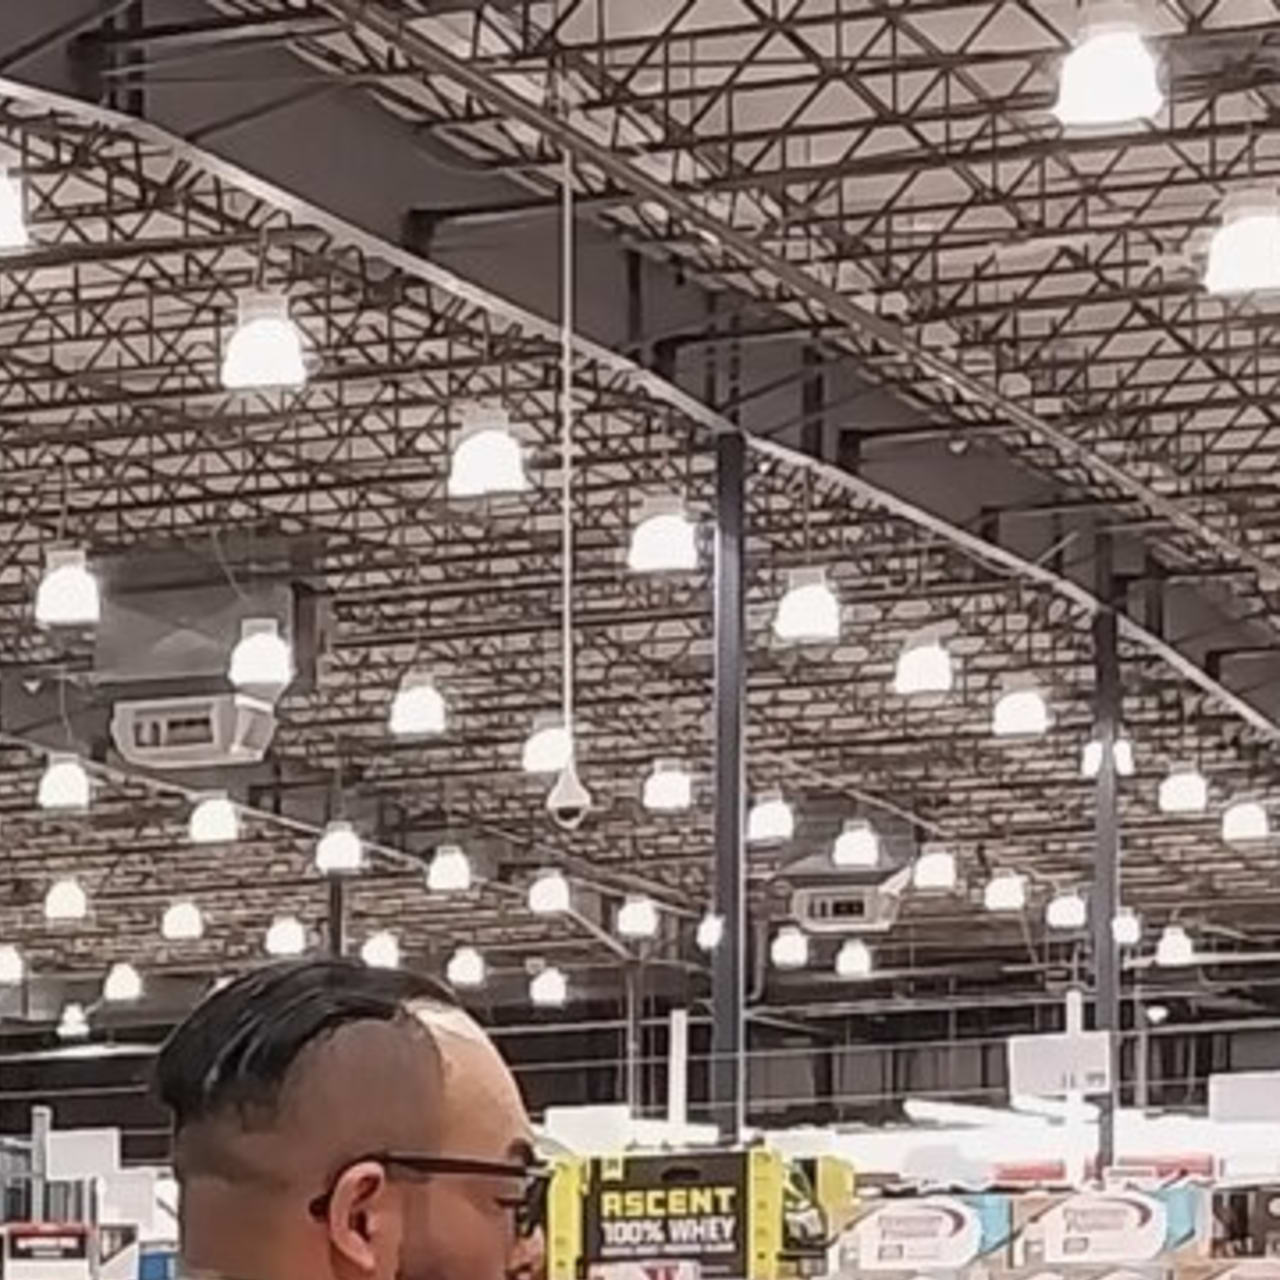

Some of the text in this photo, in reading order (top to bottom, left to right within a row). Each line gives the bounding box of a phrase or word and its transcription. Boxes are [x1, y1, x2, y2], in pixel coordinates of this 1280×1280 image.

[600, 1187, 736, 1217] ASCENT
[601, 1215, 736, 1244] 100% WHEY
